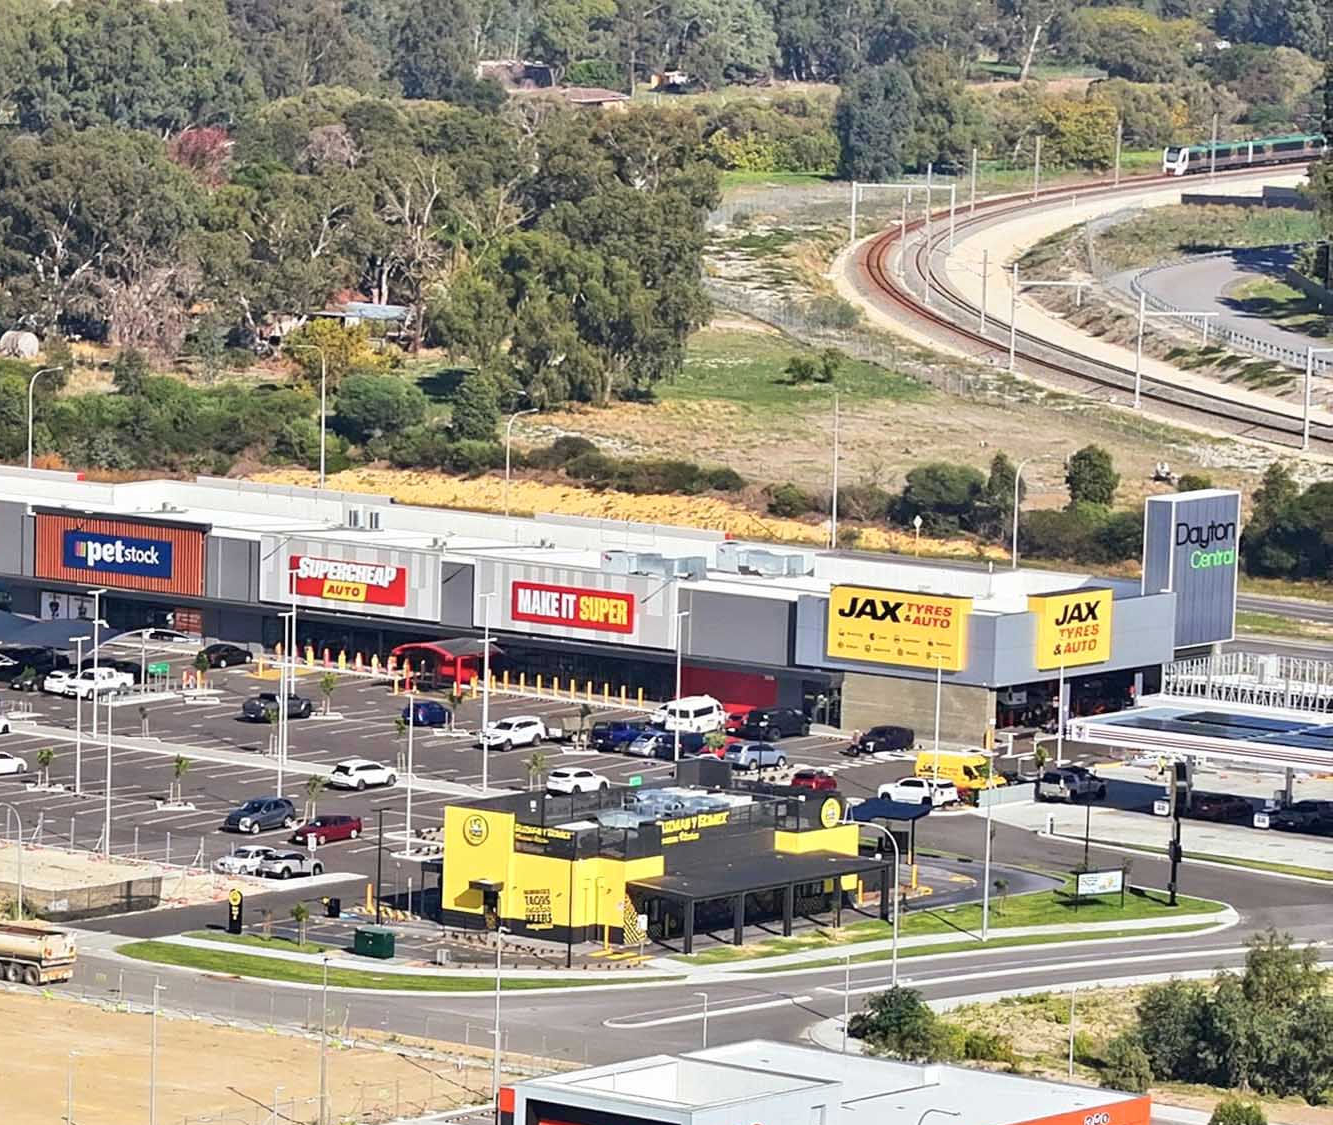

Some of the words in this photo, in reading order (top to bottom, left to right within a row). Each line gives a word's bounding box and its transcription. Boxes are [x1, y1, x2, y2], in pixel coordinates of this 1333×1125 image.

[1176, 520, 1235, 549] Dayton
[1190, 547, 1235, 569] Central
[297, 557, 396, 588] SUPERCHEAP
[326, 585, 360, 597] AUTO
[517, 588, 560, 617] MAKE
[561, 593, 576, 619] IT
[579, 595, 628, 625] SUPER
[838, 597, 904, 623] JAX
[907, 602, 952, 617] TYRES
[1055, 600, 1101, 626] JAX
[912, 616, 950, 629] AUTO
[1059, 624, 1100, 639] TYRES
[1053, 644, 1062, 656] &
[1063, 638, 1097, 654] AUTO
